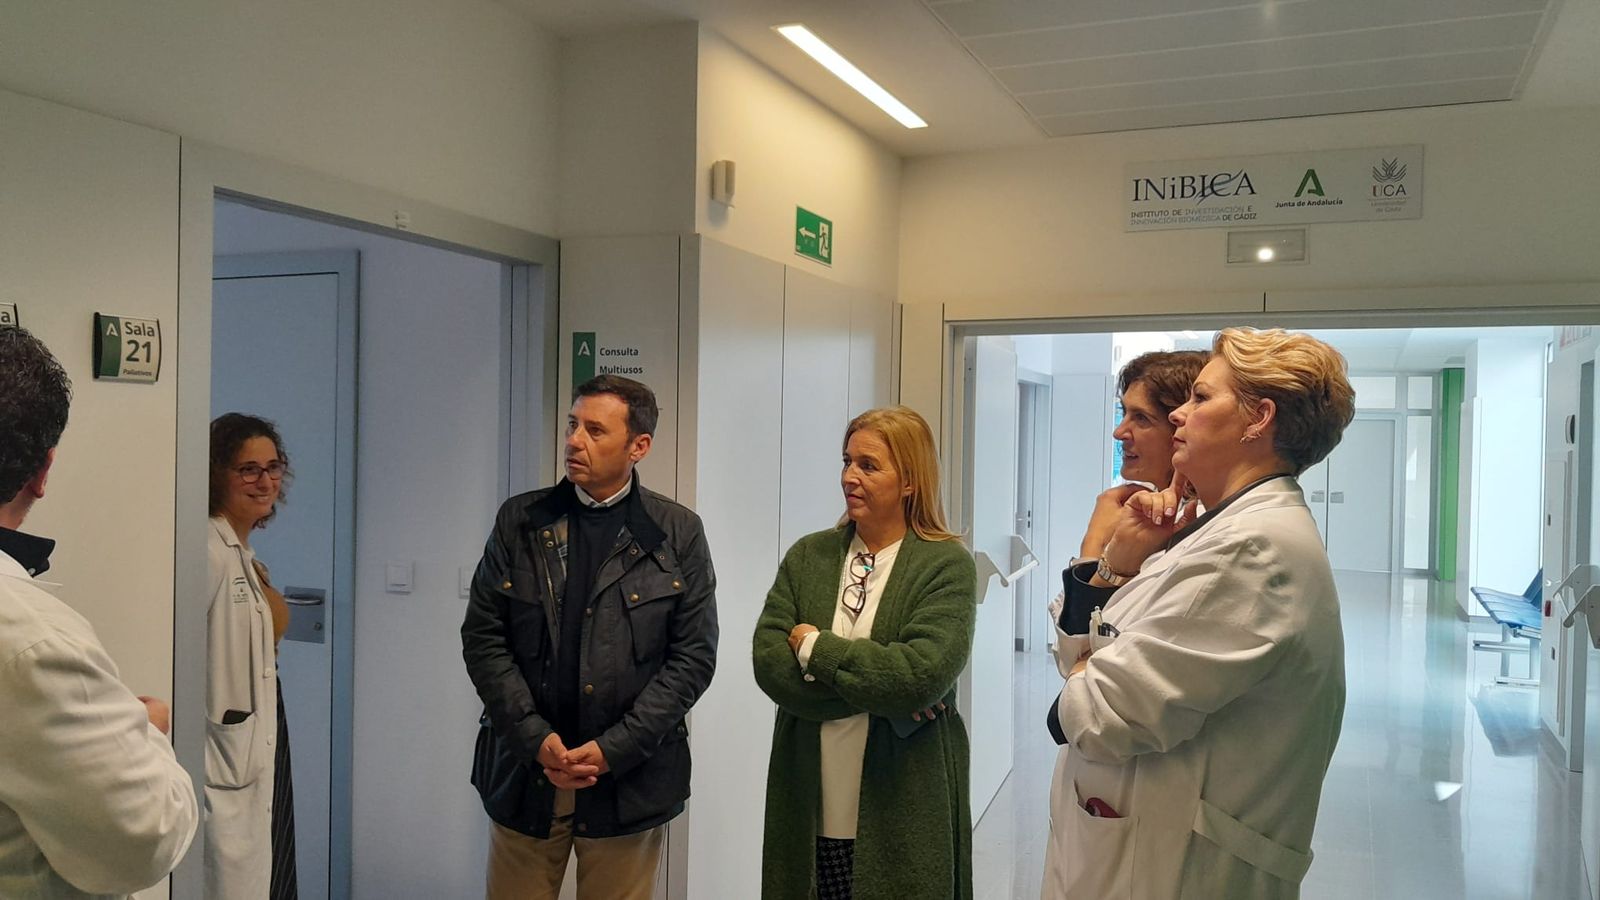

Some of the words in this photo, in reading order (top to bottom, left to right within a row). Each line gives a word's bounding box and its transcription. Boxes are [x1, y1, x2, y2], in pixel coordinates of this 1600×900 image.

[1132, 169, 1257, 204] INiBICA
[1372, 184, 1407, 198] UCA
[1307, 197, 1343, 206] Andalucía
[1131, 209, 1170, 218] INSTITUTO
[1172, 209, 1183, 217] DE
[1247, 205, 1253, 213] E
[1222, 214, 1232, 222] DE
[1234, 212, 1258, 221] CÁDIZ
[125, 322, 155, 337] Sala
[126, 339, 152, 363] 21
[600, 347, 639, 356] Consulta
[600, 365, 643, 374] Multiusos
